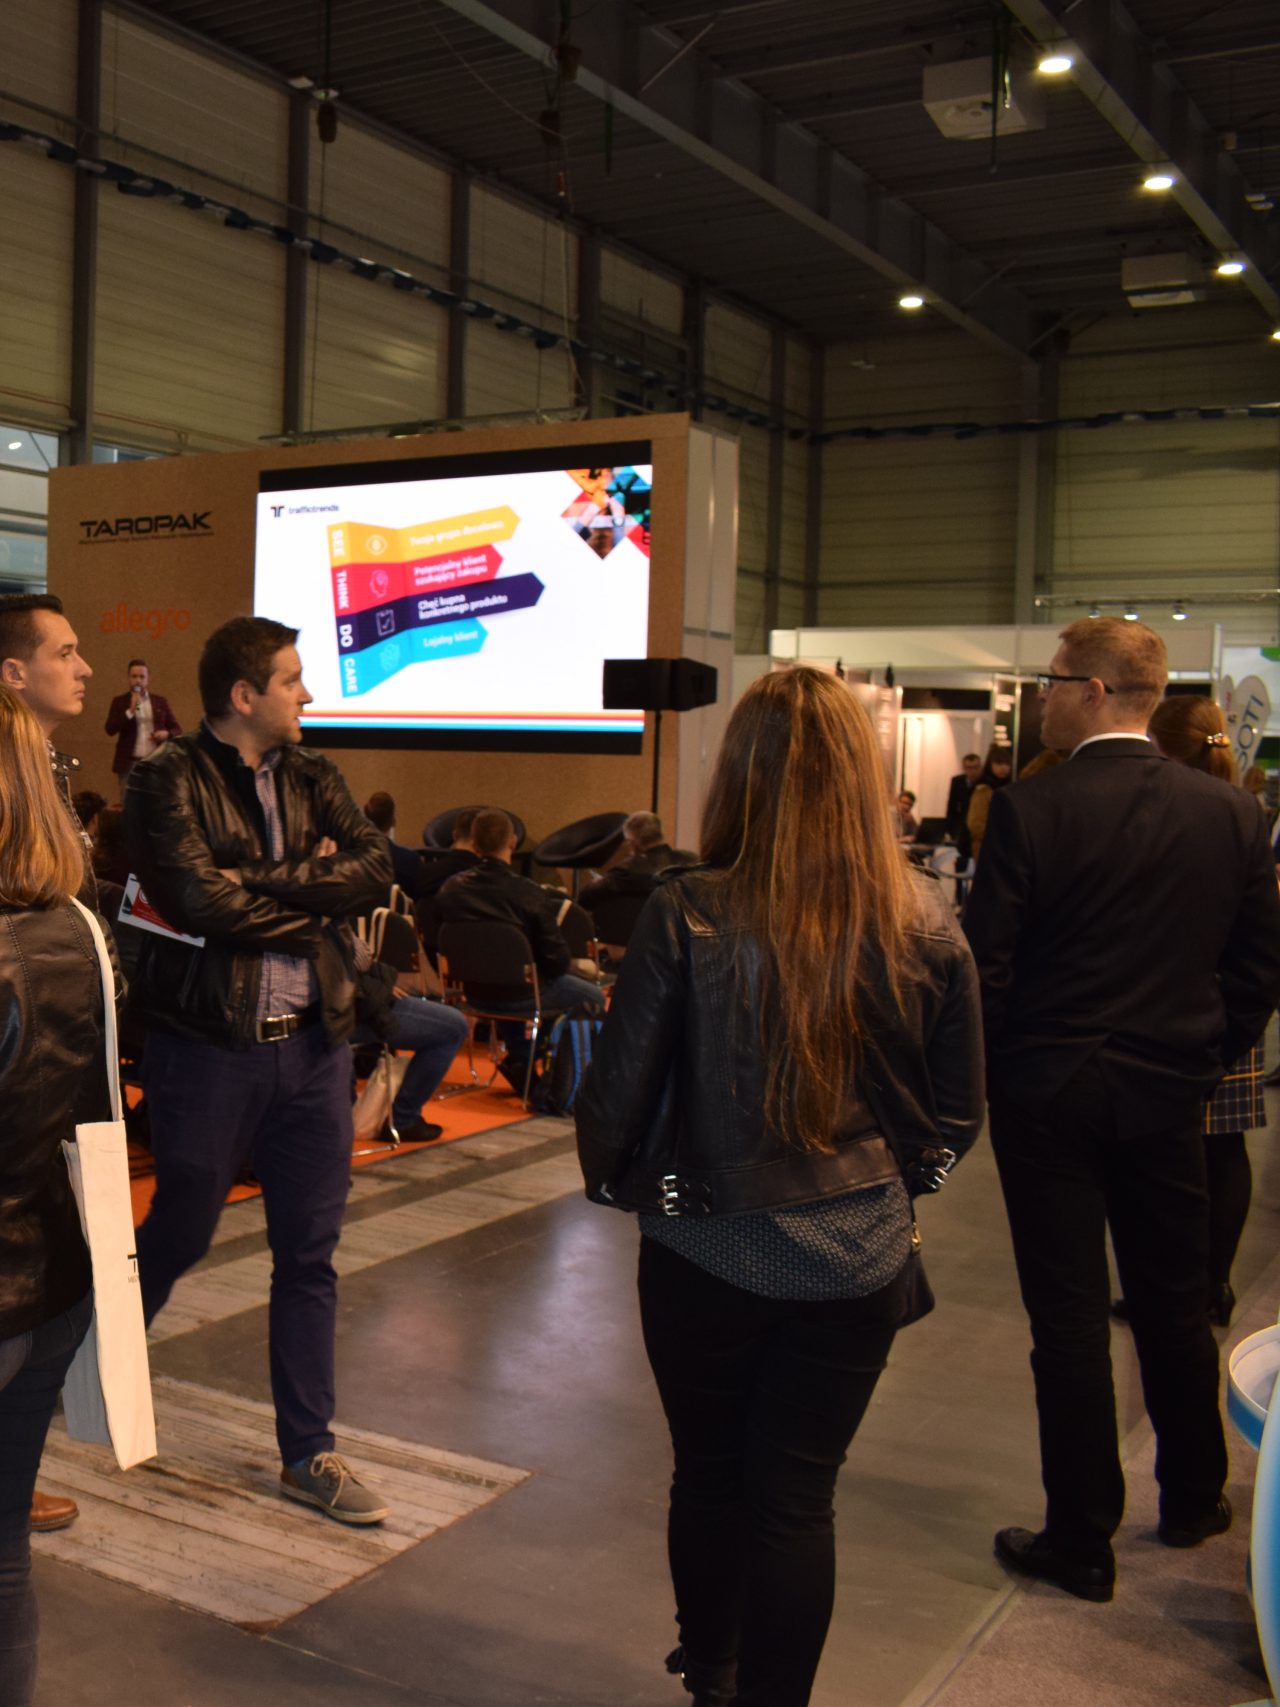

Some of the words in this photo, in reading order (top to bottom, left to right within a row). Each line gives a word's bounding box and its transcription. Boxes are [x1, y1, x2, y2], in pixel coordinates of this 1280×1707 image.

[80, 511, 212, 538] TAROPAK
[331, 529, 345, 557] SEE
[336, 569, 350, 609] THINK
[101, 602, 193, 640] allegro
[339, 623, 354, 648] DO
[343, 658, 358, 694] CARE
